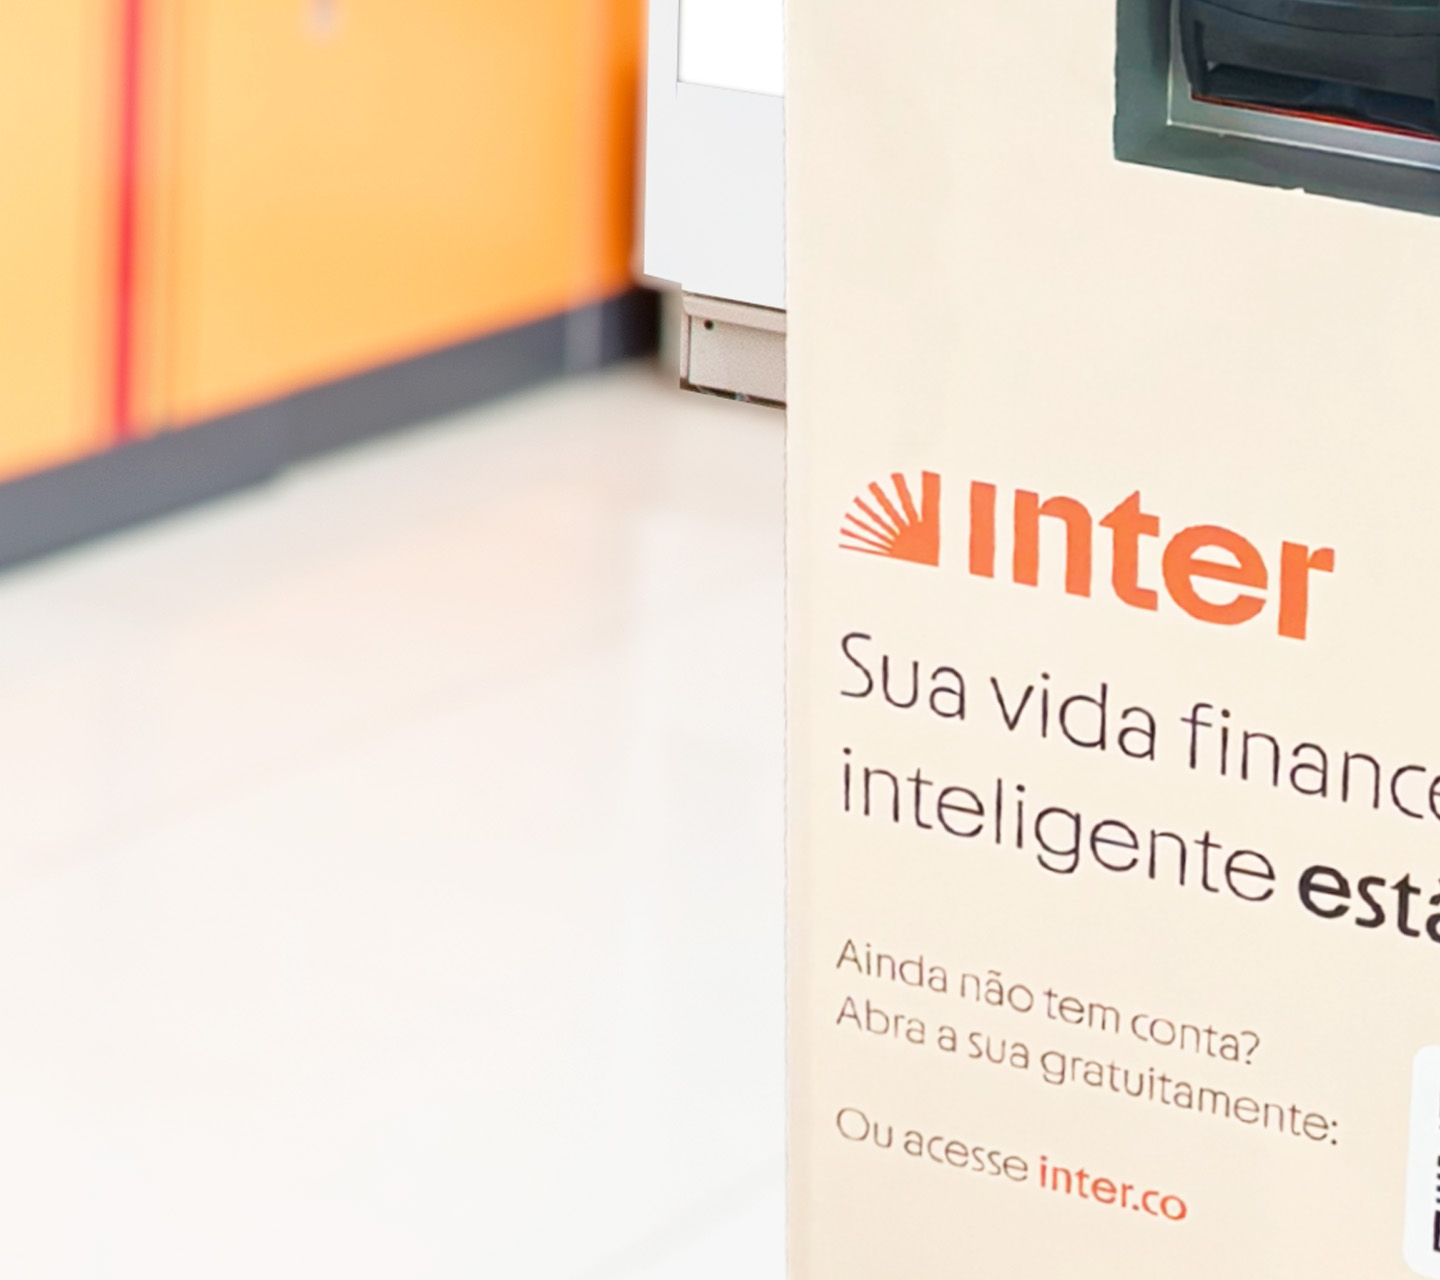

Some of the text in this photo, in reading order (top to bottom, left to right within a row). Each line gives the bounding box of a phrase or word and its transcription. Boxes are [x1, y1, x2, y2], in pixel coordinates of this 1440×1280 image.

[967, 479, 1337, 641] inter
[839, 630, 968, 722] Sua
[988, 670, 1158, 763] vida
[841, 745, 1277, 904] inteligente
[835, 937, 1261, 1067] Ainda não tem conta?
[835, 995, 1340, 1148] Abra a sua gratuitamente:
[835, 1106, 1189, 1223] Ou acesse inter.co
